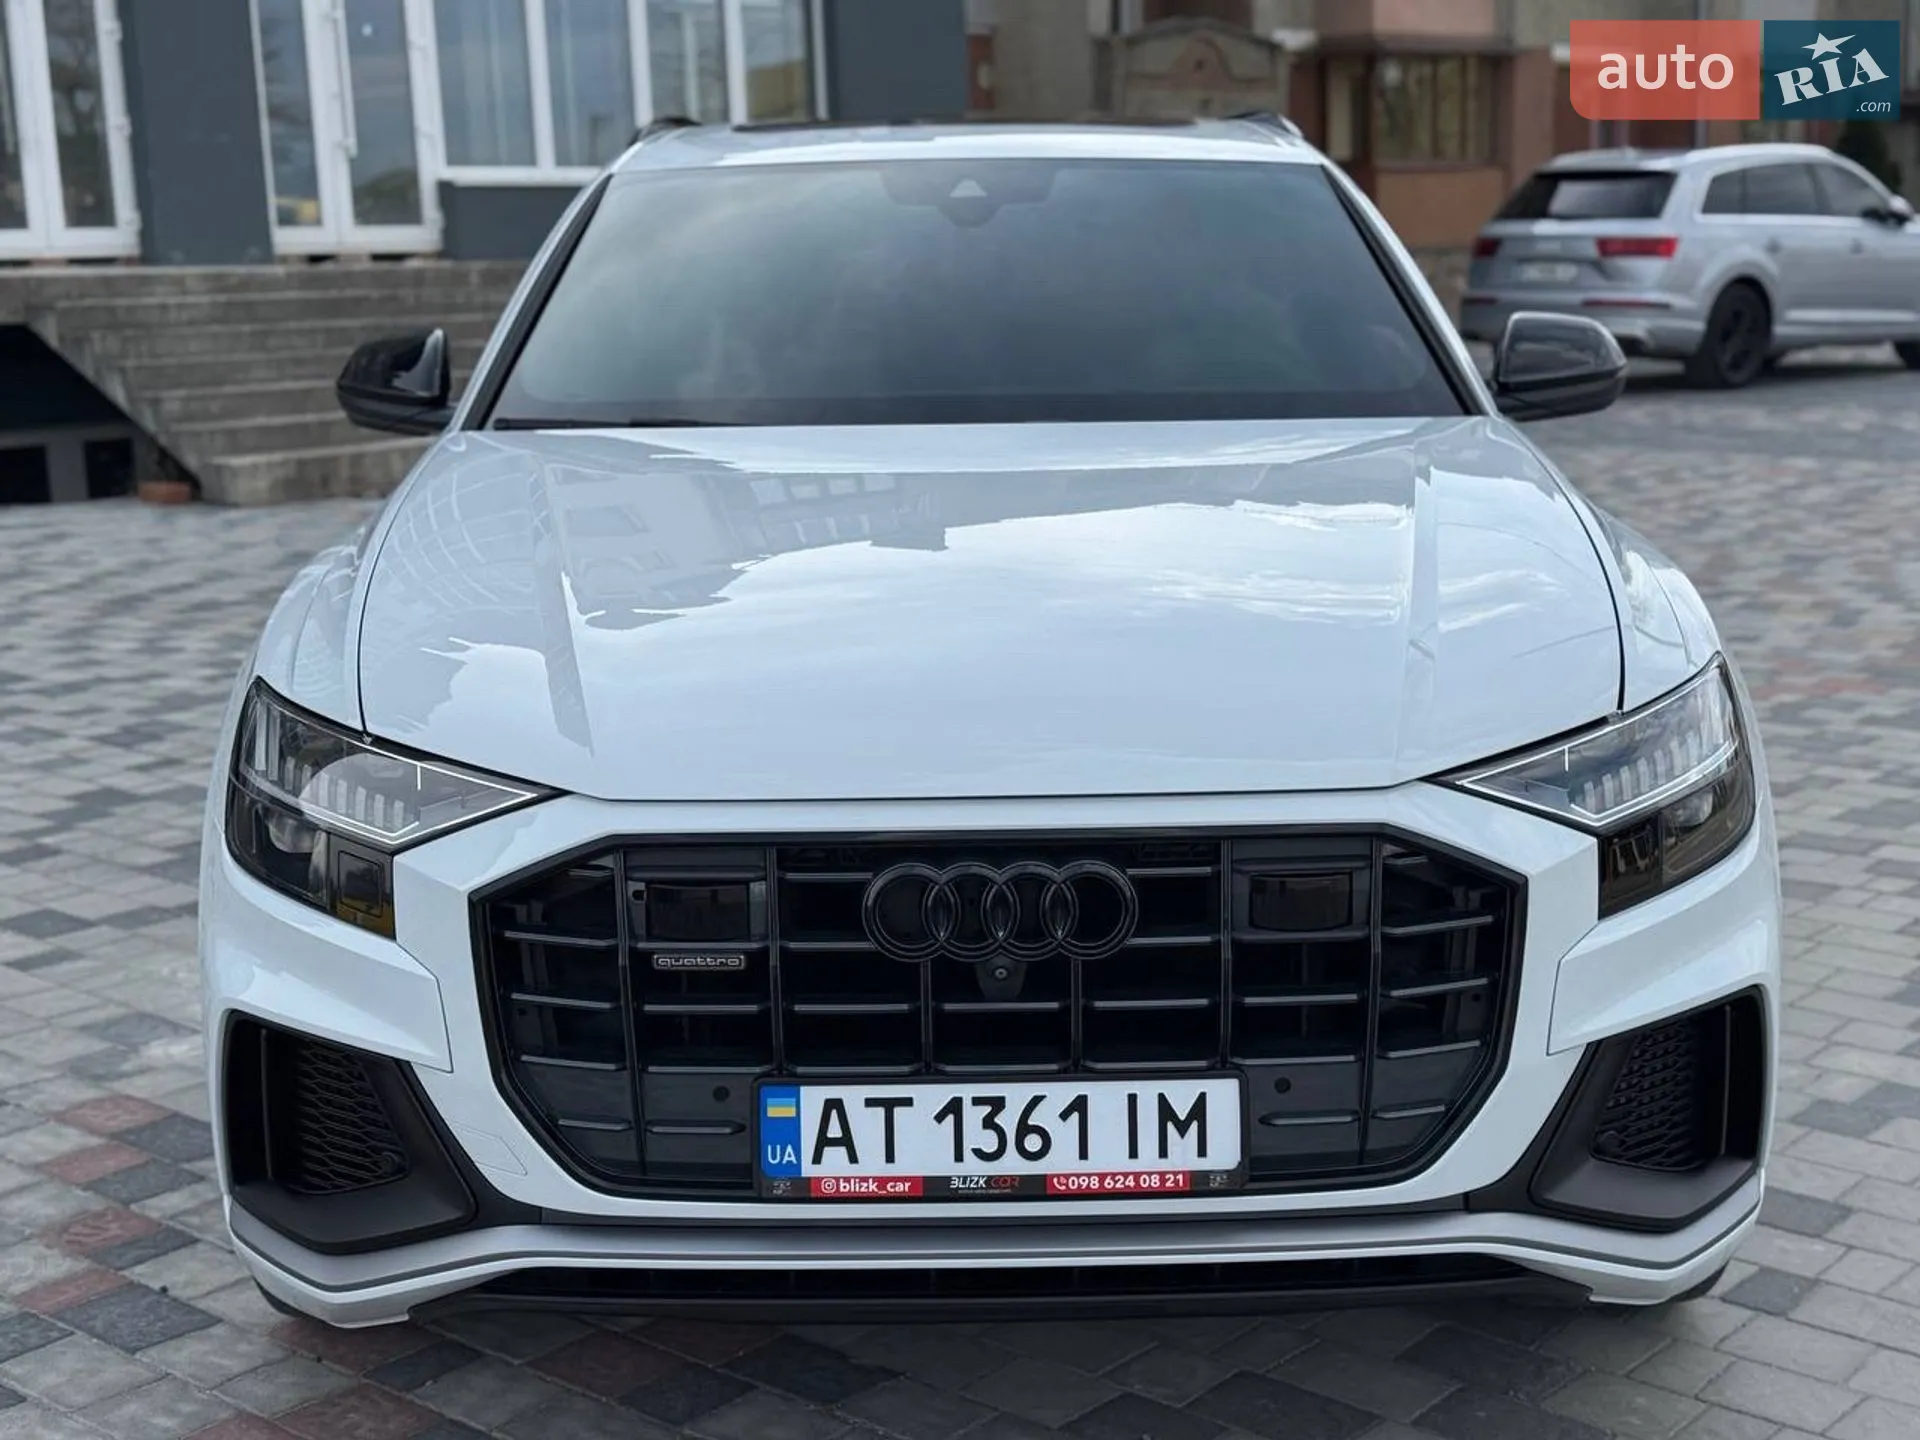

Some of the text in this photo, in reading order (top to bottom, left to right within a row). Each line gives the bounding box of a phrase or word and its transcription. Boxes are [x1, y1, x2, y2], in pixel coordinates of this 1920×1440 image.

[658, 957, 739, 968] quattro
[811, 1091, 1208, 1165] AT 1361 IM
[767, 1144, 797, 1165] UA
[839, 1178, 912, 1194] blizk_car
[1068, 1174, 1184, 1190] 098 624 08 21
